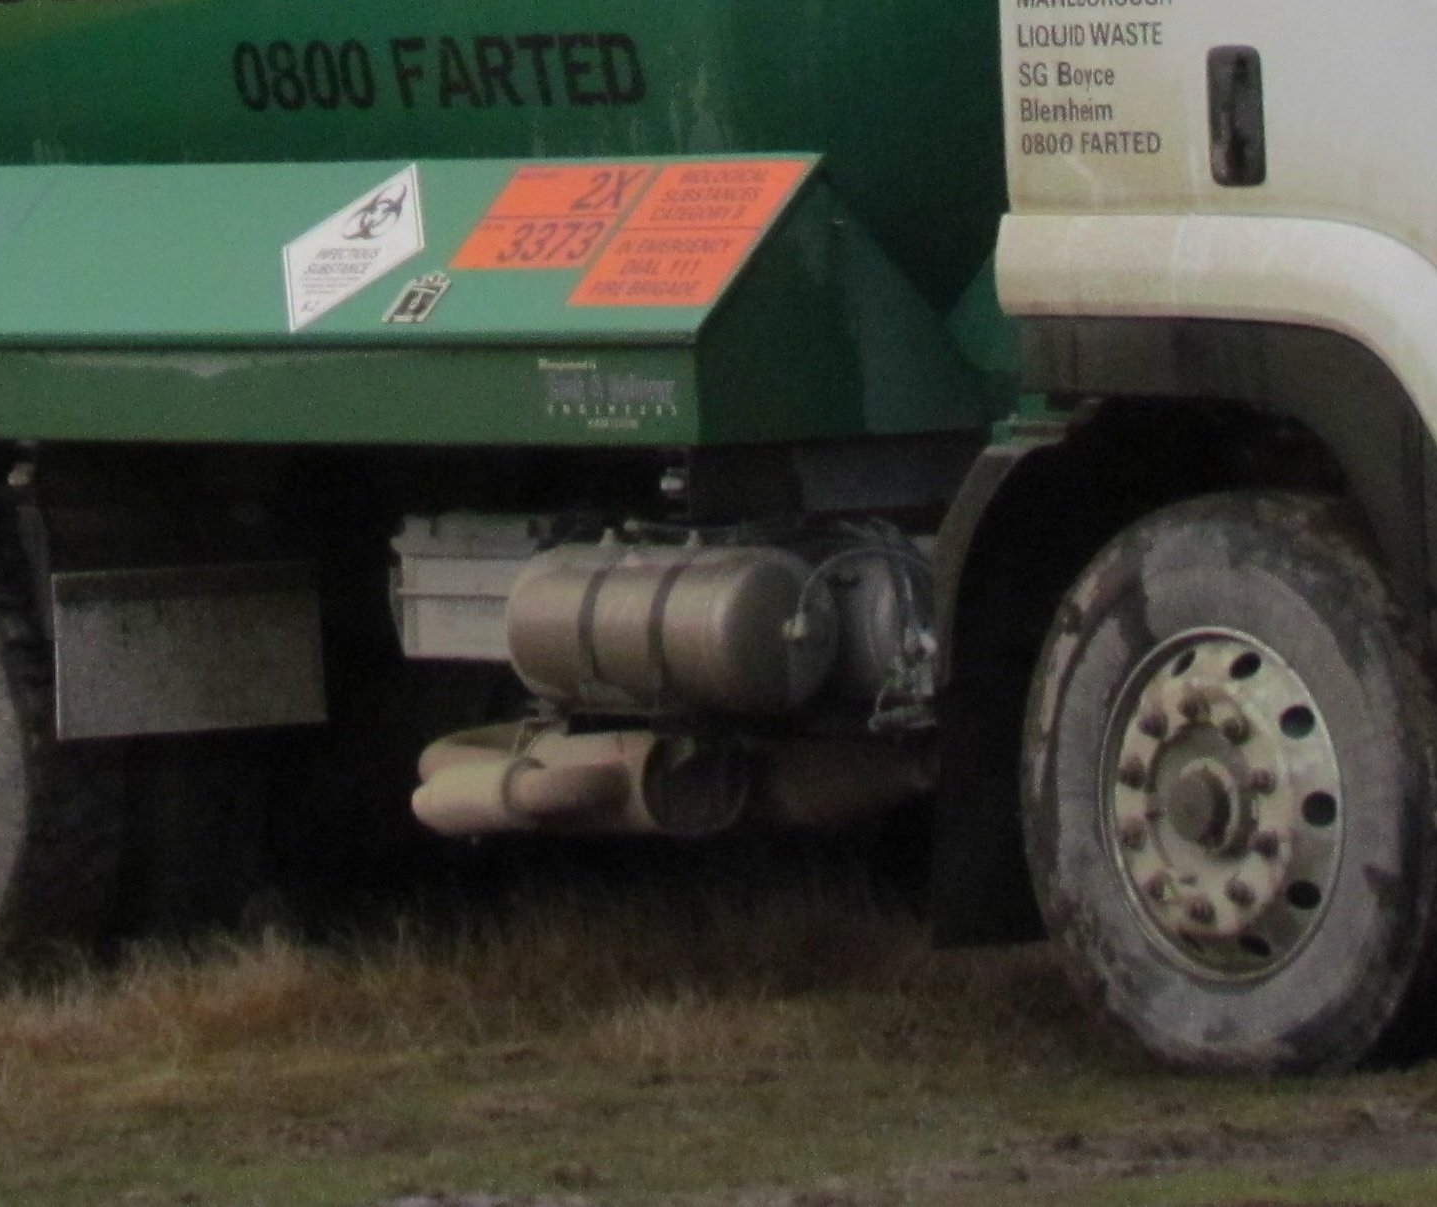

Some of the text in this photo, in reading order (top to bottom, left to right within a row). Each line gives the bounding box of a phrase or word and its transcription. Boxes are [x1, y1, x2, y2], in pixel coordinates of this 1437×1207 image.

[1017, 22, 1163, 48] LIQUID WASTE
[234, 33, 646, 112] 0800 FARTED
[1019, 61, 1115, 91] SG Boyce
[1020, 98, 1113, 122] Blenheim
[1022, 132, 1161, 156] 0800 FARTED
[570, 169, 646, 210] 2X
[496, 222, 606, 262] 3373
[637, 238, 736, 253] EMERGENCY
[619, 258, 702, 275] DIAL 111
